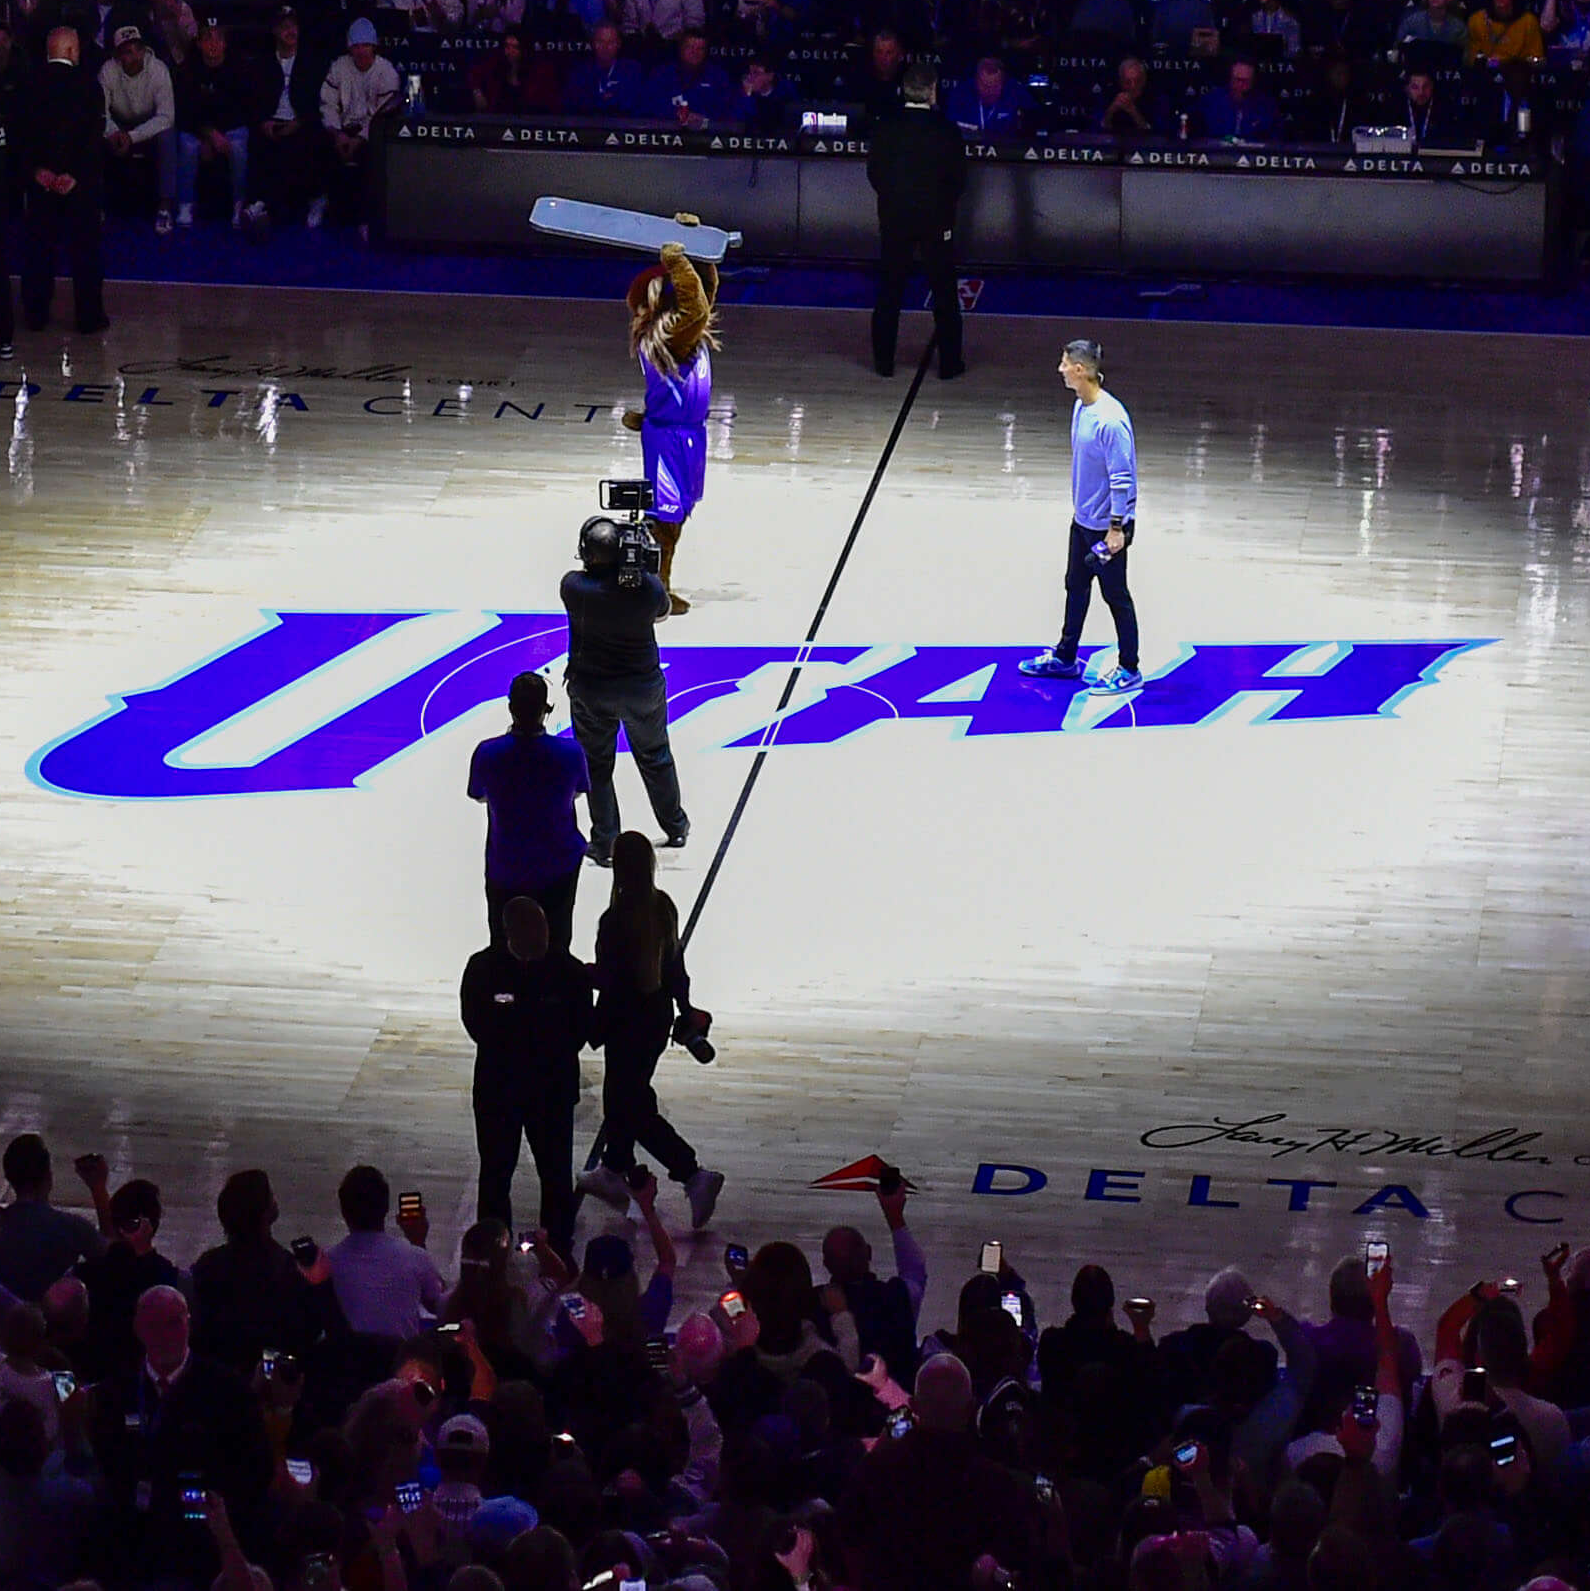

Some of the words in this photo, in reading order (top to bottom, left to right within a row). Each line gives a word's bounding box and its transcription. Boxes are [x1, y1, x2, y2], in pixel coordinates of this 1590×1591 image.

[801, 49, 848, 60] DELTA
[1058, 57, 1105, 67] DELTA
[1152, 60, 1200, 71] DELTA
[416, 124, 475, 140] DELTA
[520, 128, 580, 144] DELTA
[623, 132, 683, 147] DELTA
[728, 137, 789, 152] DELTA
[832, 139, 868, 154] DEL
[965, 143, 998, 159] LTA
[1044, 147, 1104, 162] DELTA
[1148, 151, 1209, 166] DELTA
[1255, 155, 1316, 170] DELTA
[1362, 158, 1425, 174] DELTA
[1471, 161, 1532, 177] DELTA
[363, 395, 737, 429] CENTR
[1360, 1127, 1553, 1166] Miller
[972, 1162, 1430, 1219] DELTA
